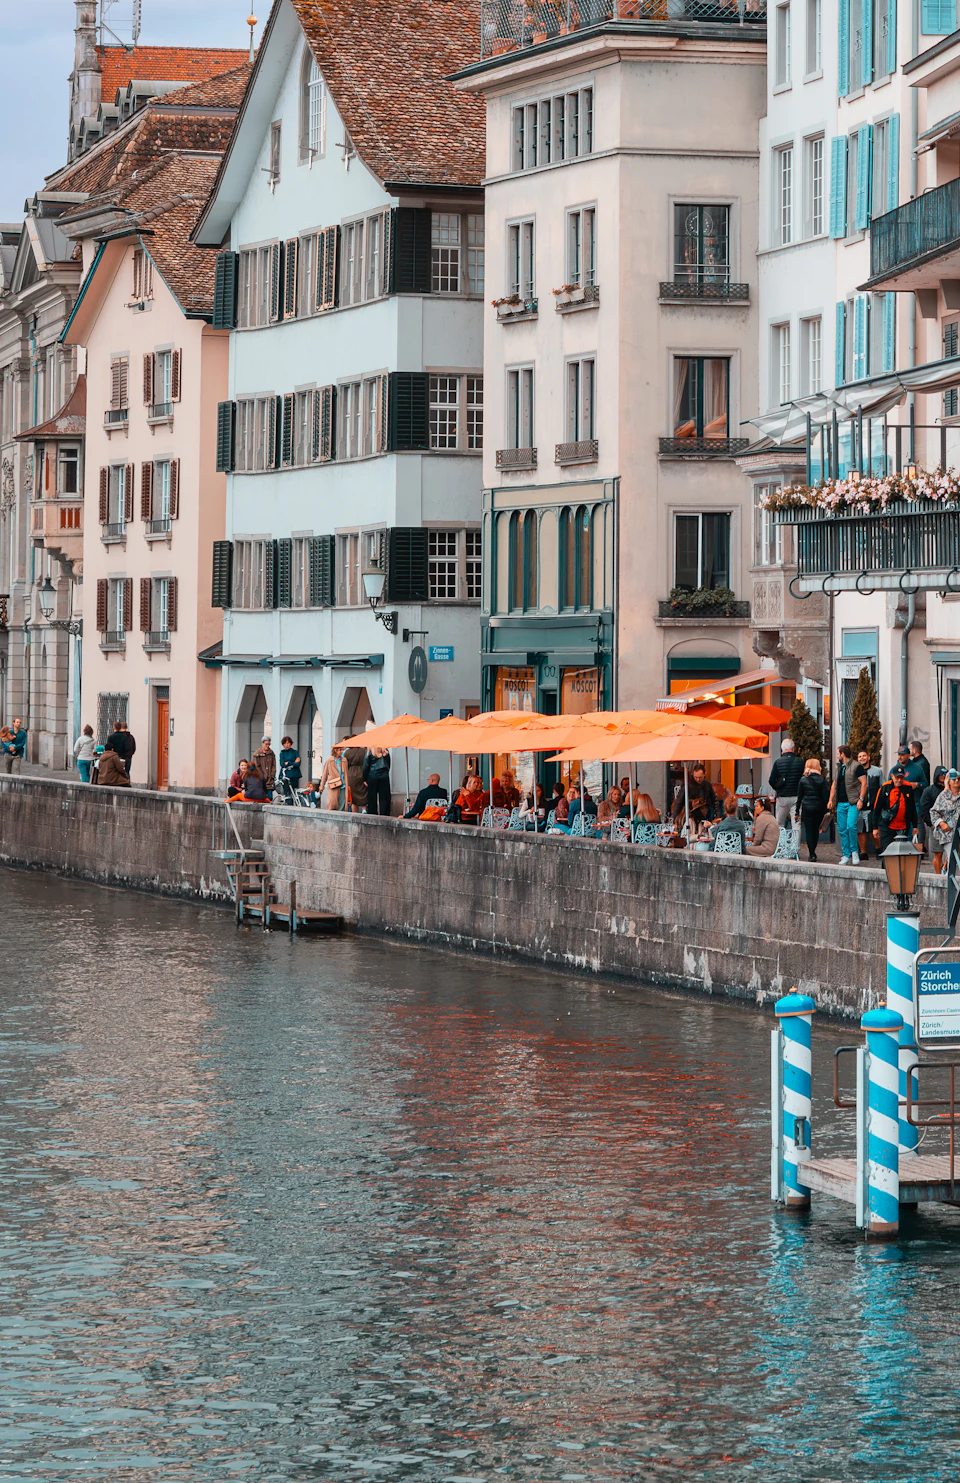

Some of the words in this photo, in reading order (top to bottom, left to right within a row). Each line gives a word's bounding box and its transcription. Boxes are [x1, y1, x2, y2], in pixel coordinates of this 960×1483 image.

[432, 646, 451, 654] Zinnen-
[504, 680, 529, 692] MOSCOT
[571, 679, 597, 693] MOSCOT
[920, 970, 952, 981] Zürich
